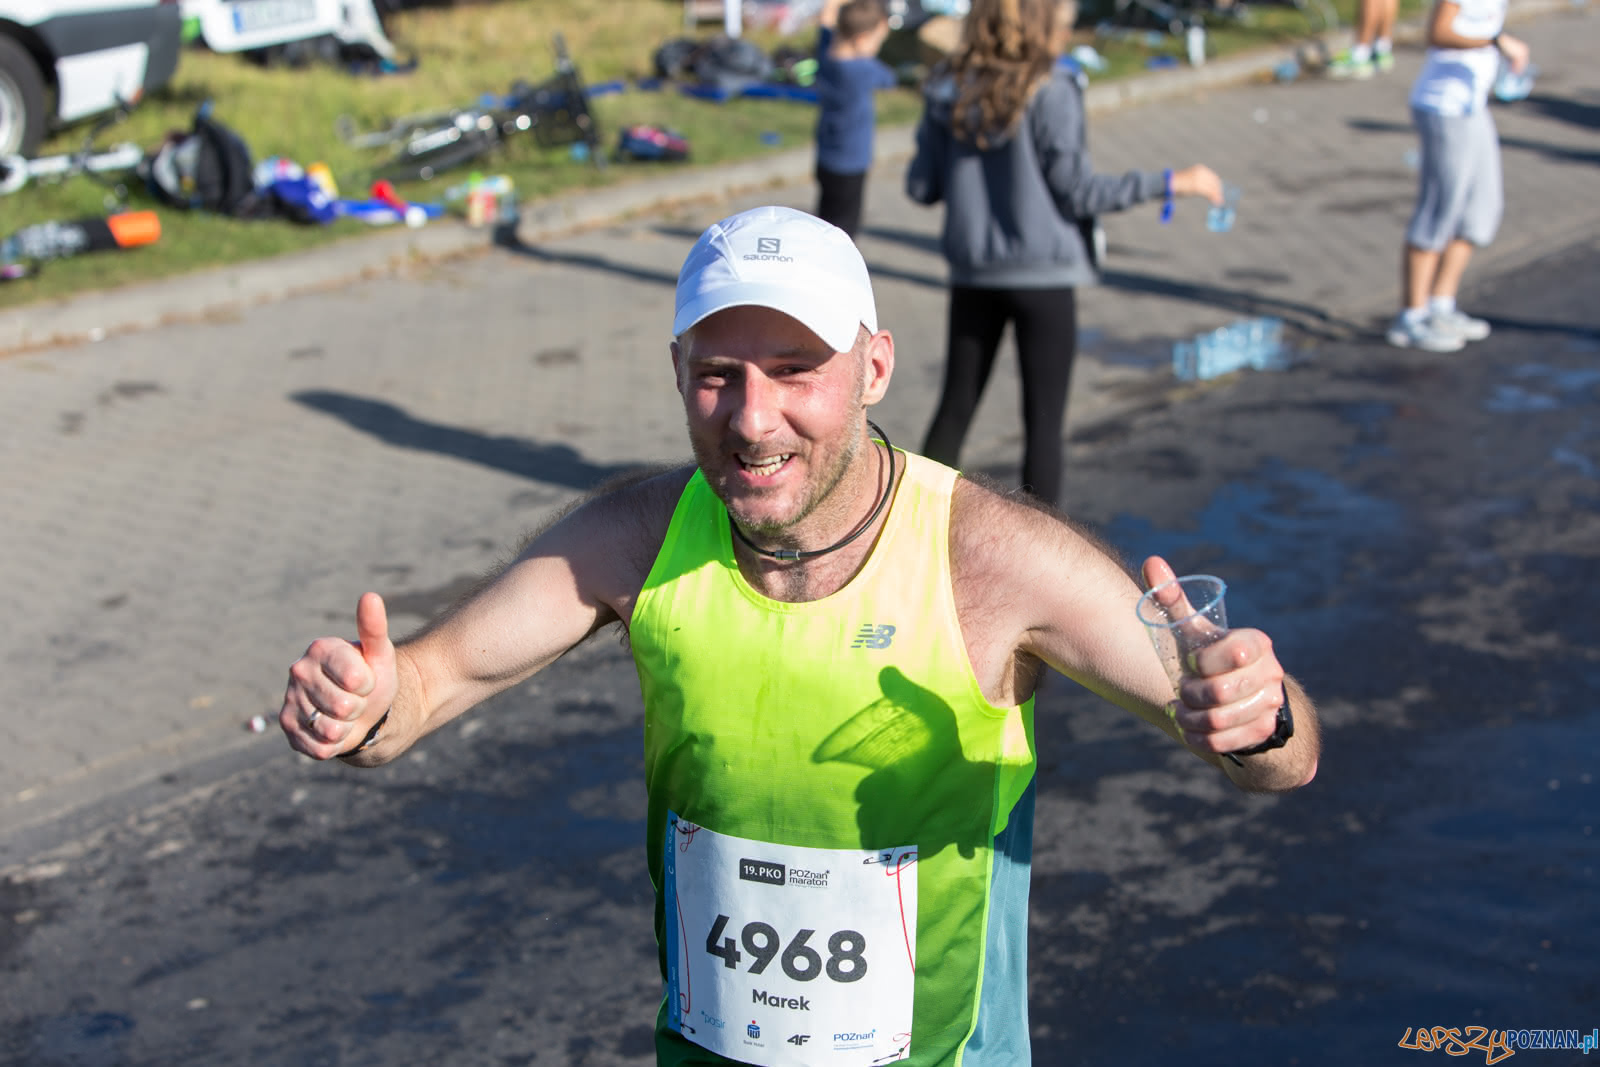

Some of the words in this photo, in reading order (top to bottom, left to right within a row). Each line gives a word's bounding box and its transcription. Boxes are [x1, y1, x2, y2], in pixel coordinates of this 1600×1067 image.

[743, 865, 758, 876] 19.
[759, 866, 782, 880] PKO
[789, 877, 828, 887] maraton
[706, 914, 868, 983] 4968
[752, 989, 810, 1011] Marek
[787, 1034, 811, 1046] 4F
